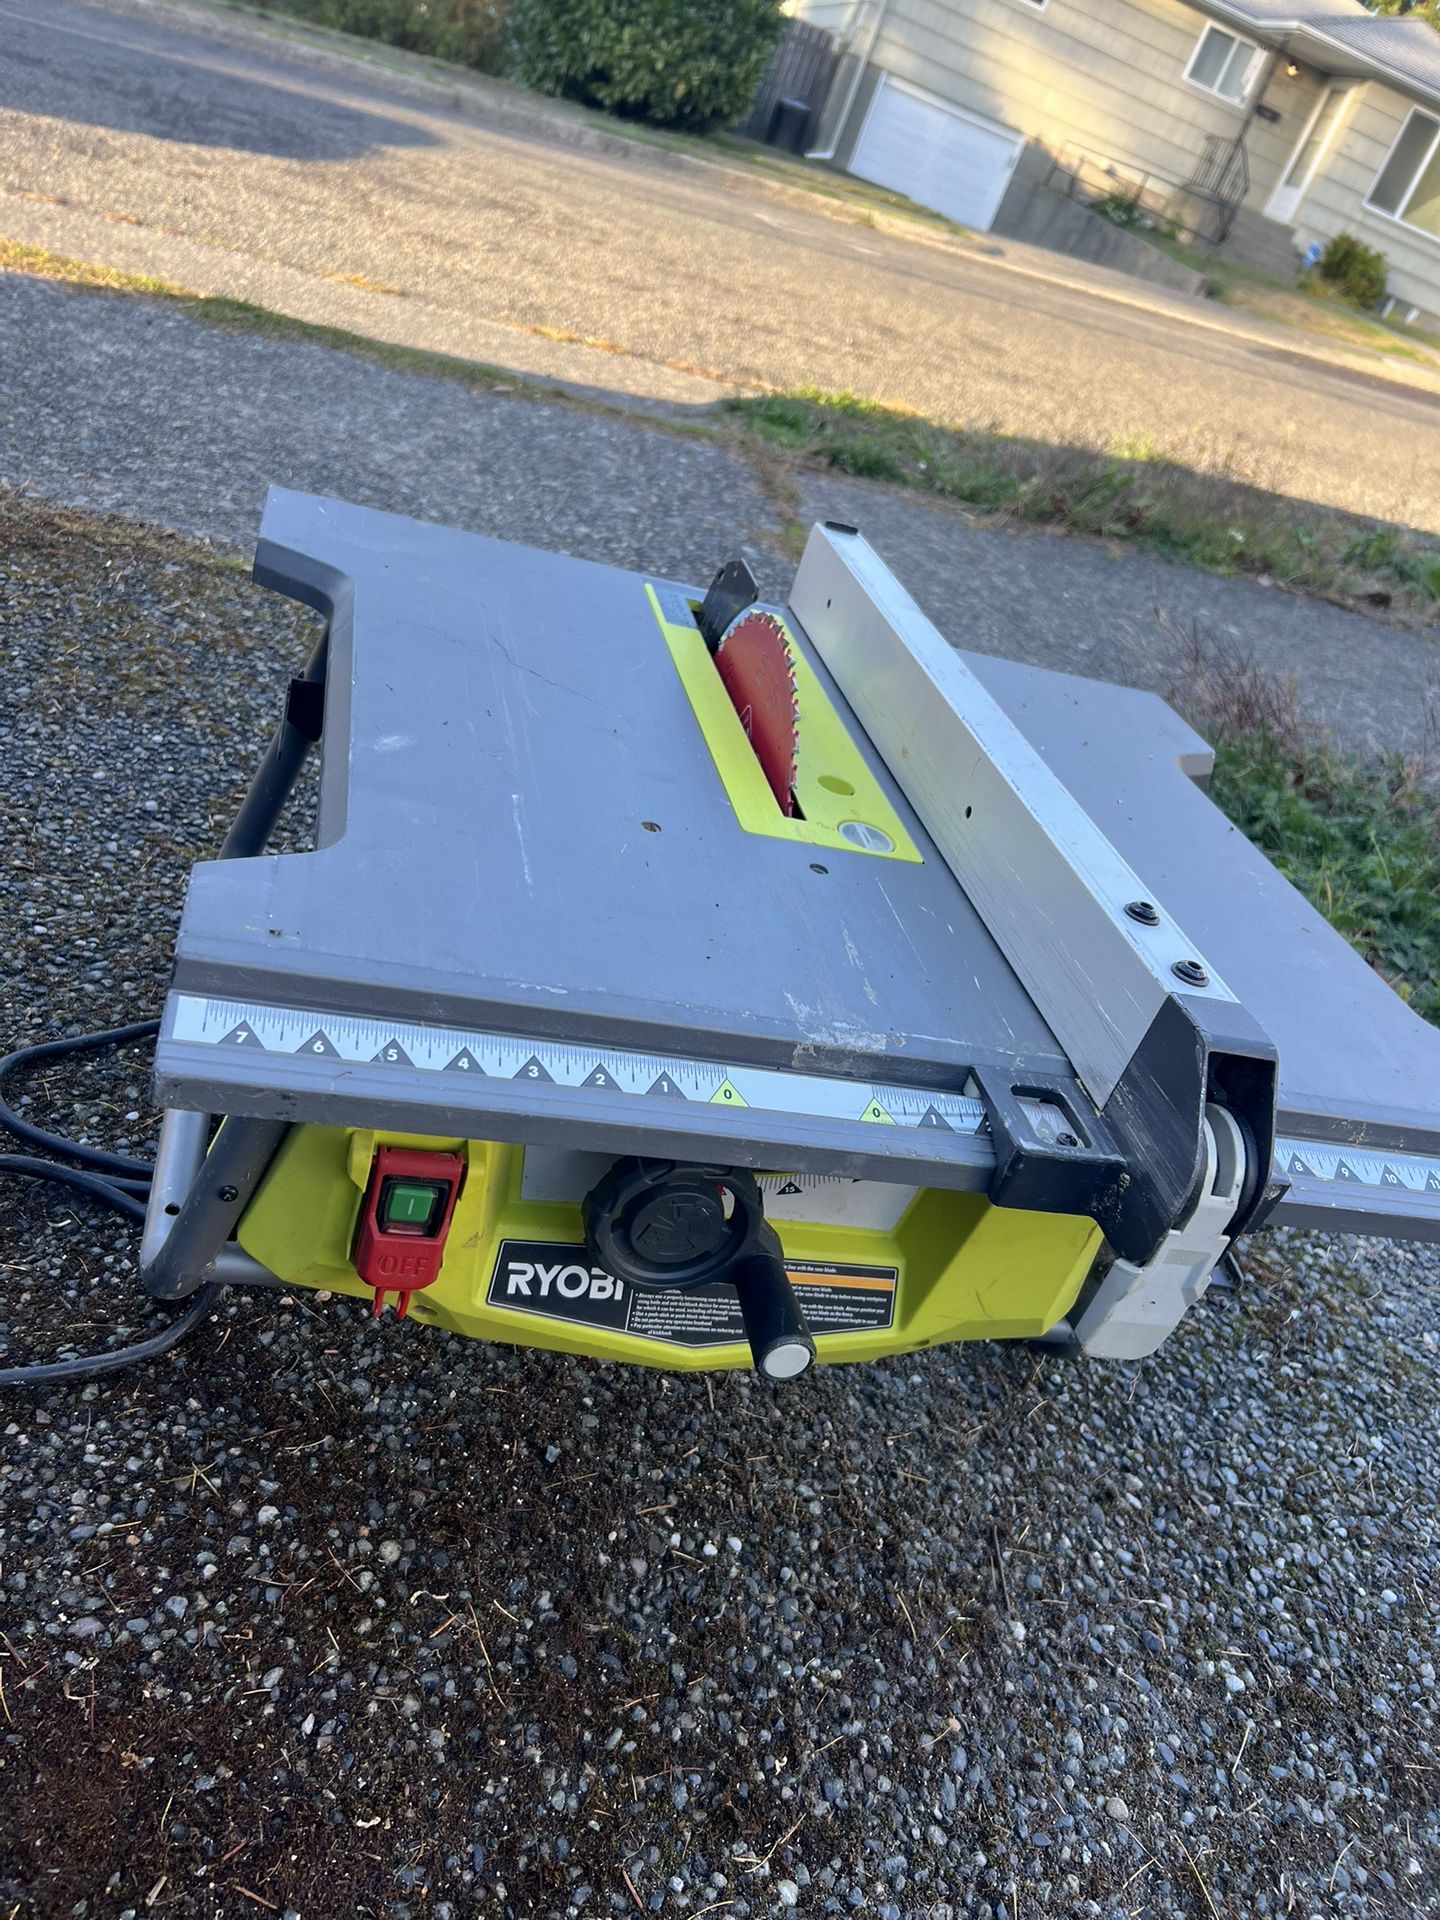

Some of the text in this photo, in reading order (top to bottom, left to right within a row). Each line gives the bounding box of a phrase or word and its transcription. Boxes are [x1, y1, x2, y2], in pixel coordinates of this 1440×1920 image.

[236, 1031, 732, 1100] 7 6 5 4 3 2 1 0
[872, 1107, 881, 1118] 0
[930, 1114, 938, 1125] 1
[1294, 1161, 1303, 1172] 8
[1341, 1167, 1349, 1178] 9
[1385, 1173, 1397, 1184] 10
[379, 1254, 429, 1277] OFF
[506, 1261, 625, 1301] RYOBI
